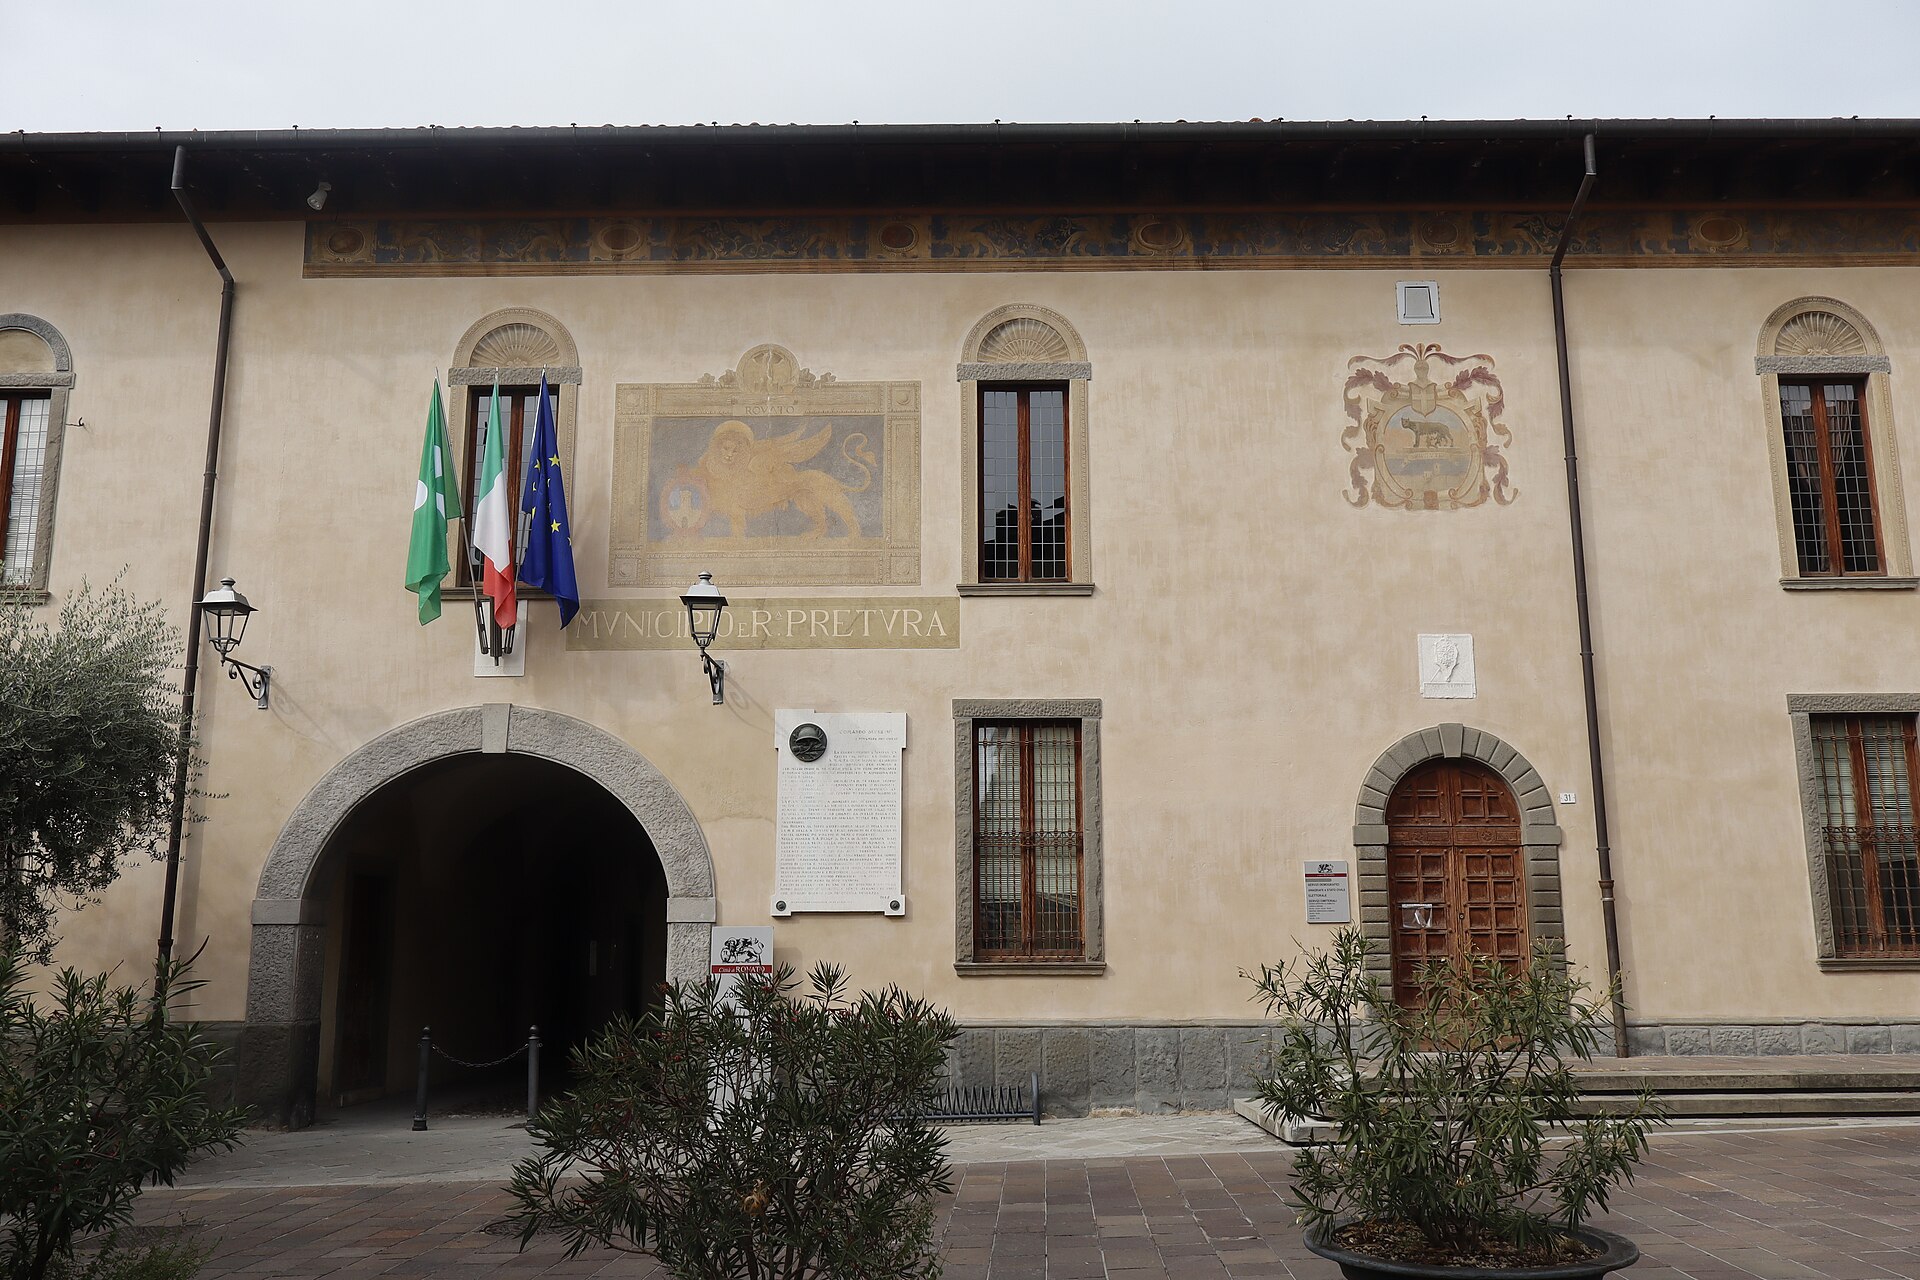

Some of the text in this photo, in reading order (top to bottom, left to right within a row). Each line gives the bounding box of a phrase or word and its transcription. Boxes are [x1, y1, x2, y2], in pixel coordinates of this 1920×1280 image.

[745, 405, 795, 415] ROVATO
[786, 608, 948, 638] PRETVRA
[1564, 794, 1571, 802] 31
